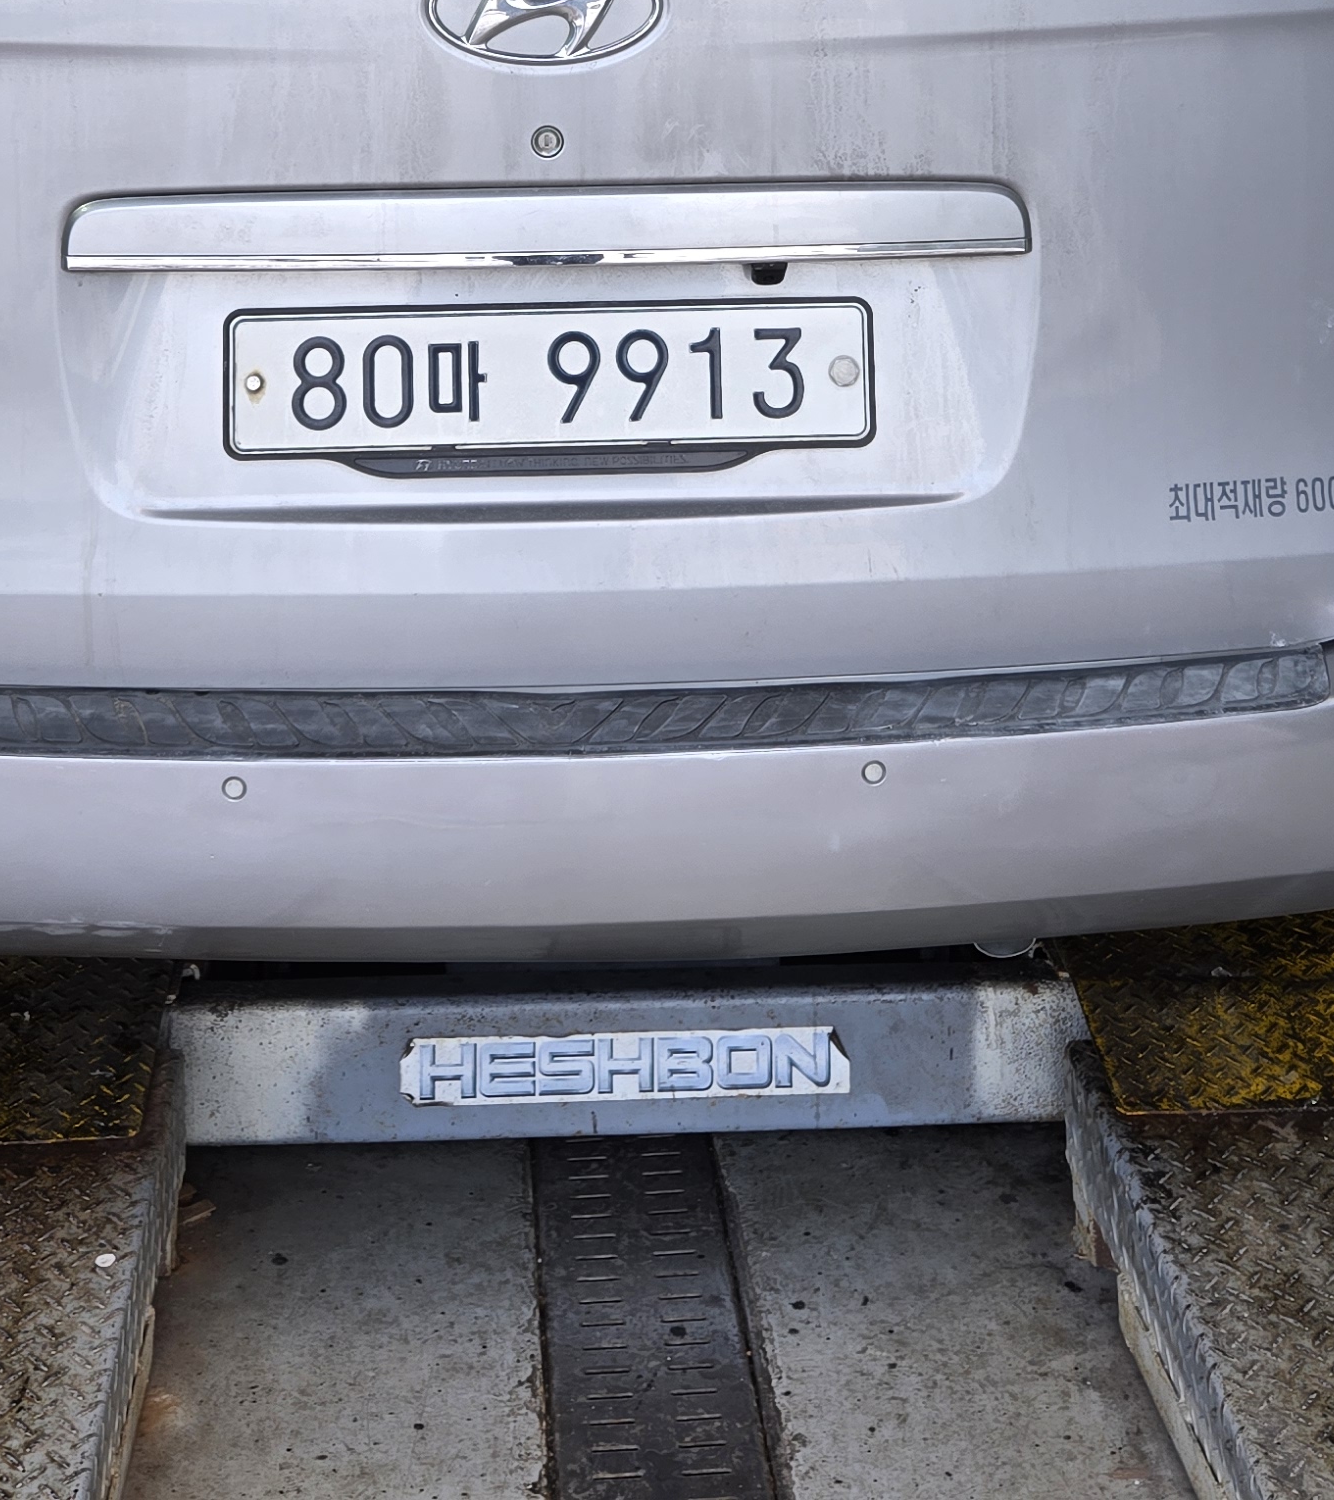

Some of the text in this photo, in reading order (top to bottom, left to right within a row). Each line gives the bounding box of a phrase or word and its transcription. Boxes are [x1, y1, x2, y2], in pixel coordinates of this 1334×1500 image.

[291, 326, 806, 431] 80마 9913
[1168, 476, 1288, 522] 최대적재량
[419, 1032, 832, 1100] HESHBON
